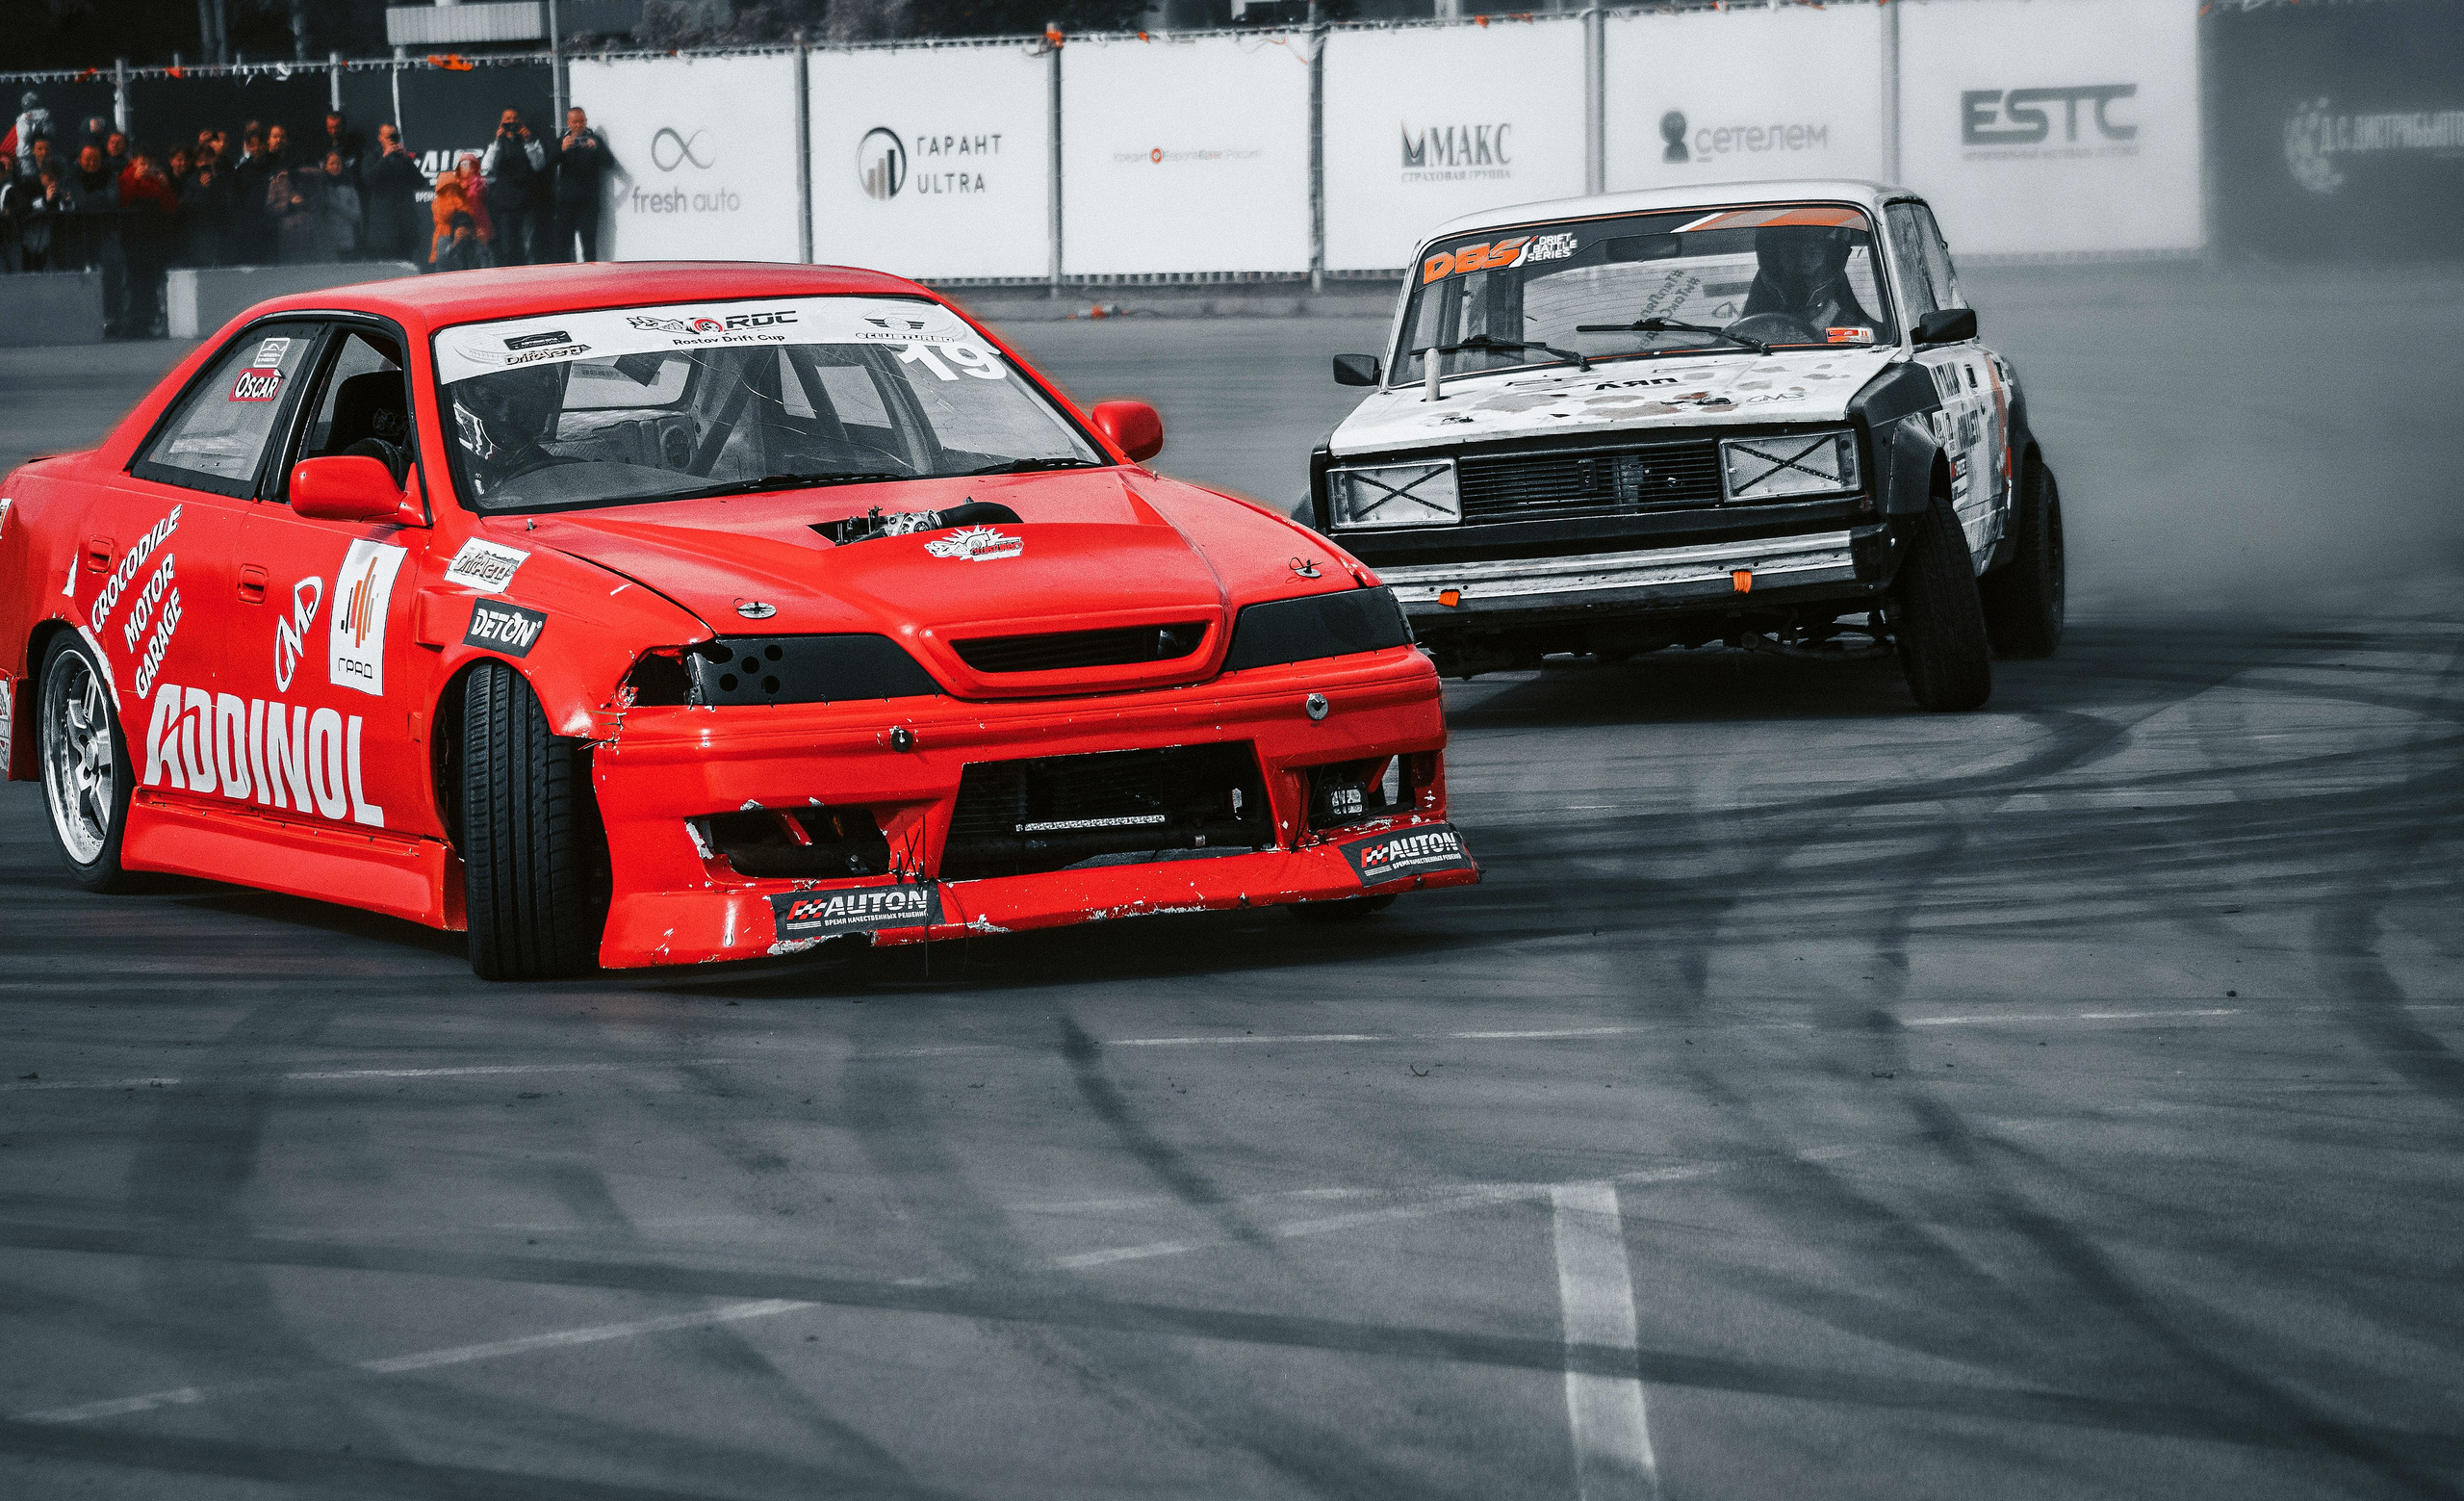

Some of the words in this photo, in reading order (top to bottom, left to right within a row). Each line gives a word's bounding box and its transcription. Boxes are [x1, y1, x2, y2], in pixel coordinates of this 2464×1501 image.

[1962, 84, 2139, 144] ESTC
[917, 134, 1002, 156] ГАРАНТ
[1430, 123, 1511, 167] МАКС
[1694, 123, 1829, 155] сетелем
[917, 172, 986, 194] ULTRA
[632, 185, 687, 213] fresh
[693, 187, 740, 212] auto
[1533, 240, 1578, 254] BATTLE
[1539, 233, 1573, 245] DRIFT
[1424, 236, 1530, 284] DBS
[1527, 251, 1572, 262] SERIES
[725, 310, 798, 329] RDC
[897, 342, 1008, 381] 19
[234, 372, 280, 398] OSCAR
[91, 504, 183, 633] CROCODILE
[123, 553, 175, 654] MOTOR
[135, 587, 183, 699] GARAGE
[143, 683, 384, 828] ADDINOL
[1390, 832, 1459, 862] AUTON
[824, 891, 928, 917] AUTON
[824, 918, 847, 926] ВРЕМЯ
[847, 913, 897, 924] КАЧЕСТВЕННЫХ
